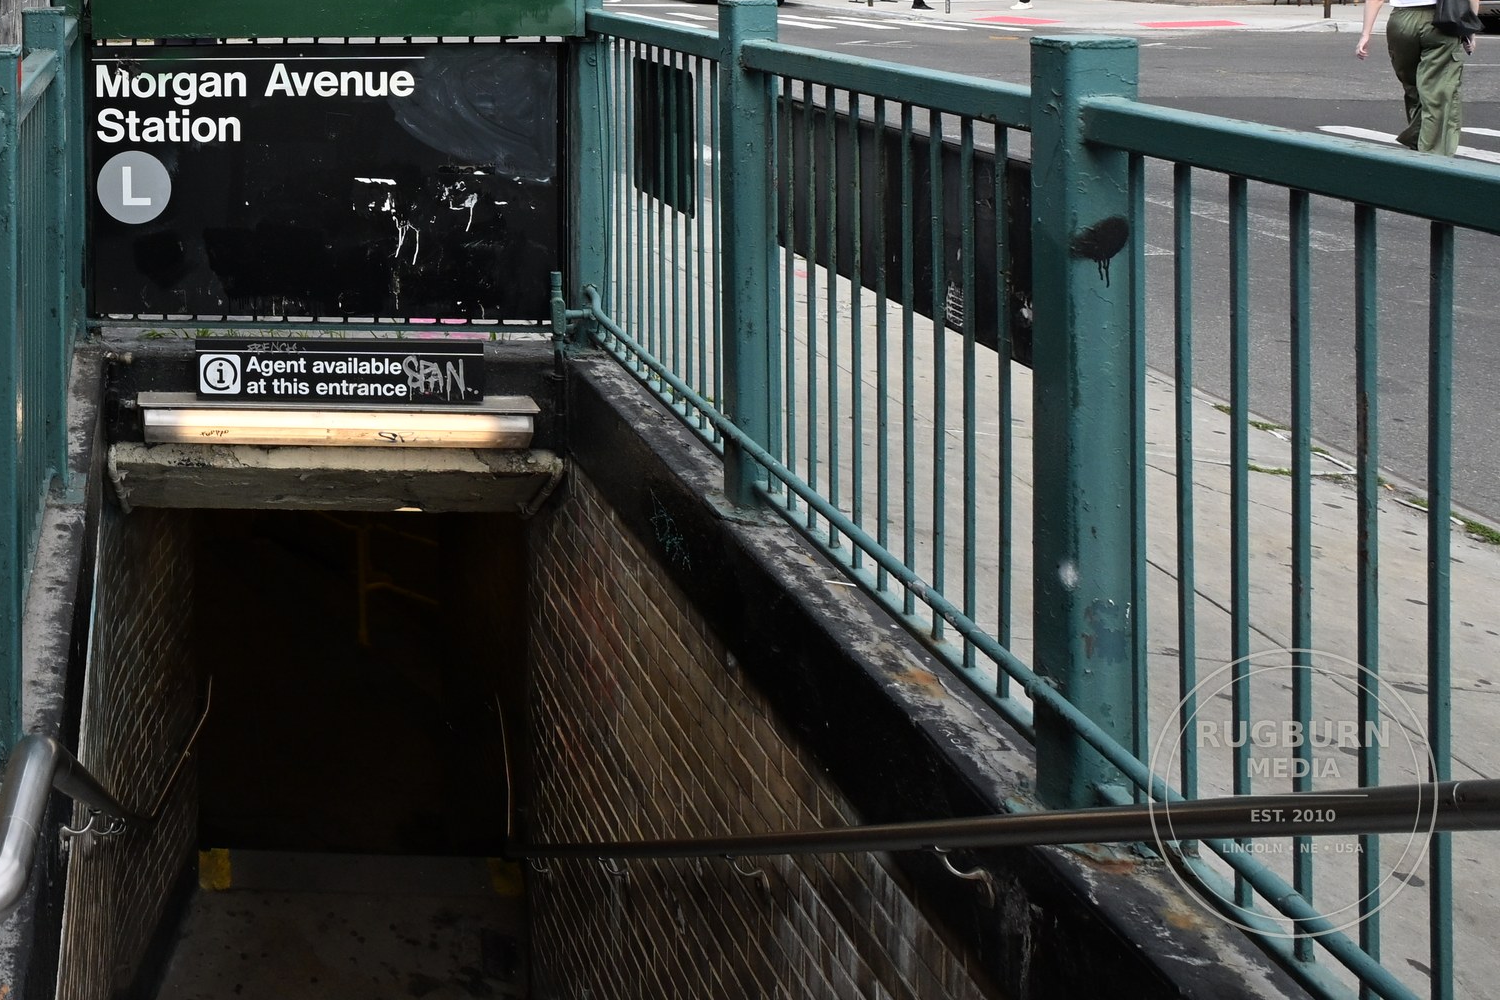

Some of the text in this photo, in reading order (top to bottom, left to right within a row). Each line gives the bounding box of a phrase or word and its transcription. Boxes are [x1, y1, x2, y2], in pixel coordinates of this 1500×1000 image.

[95, 62, 416, 106] Morgan Avenue
[96, 108, 242, 143] Station
[121, 166, 152, 206] L
[246, 356, 403, 377] Agent available
[246, 377, 408, 397] at this entrance
